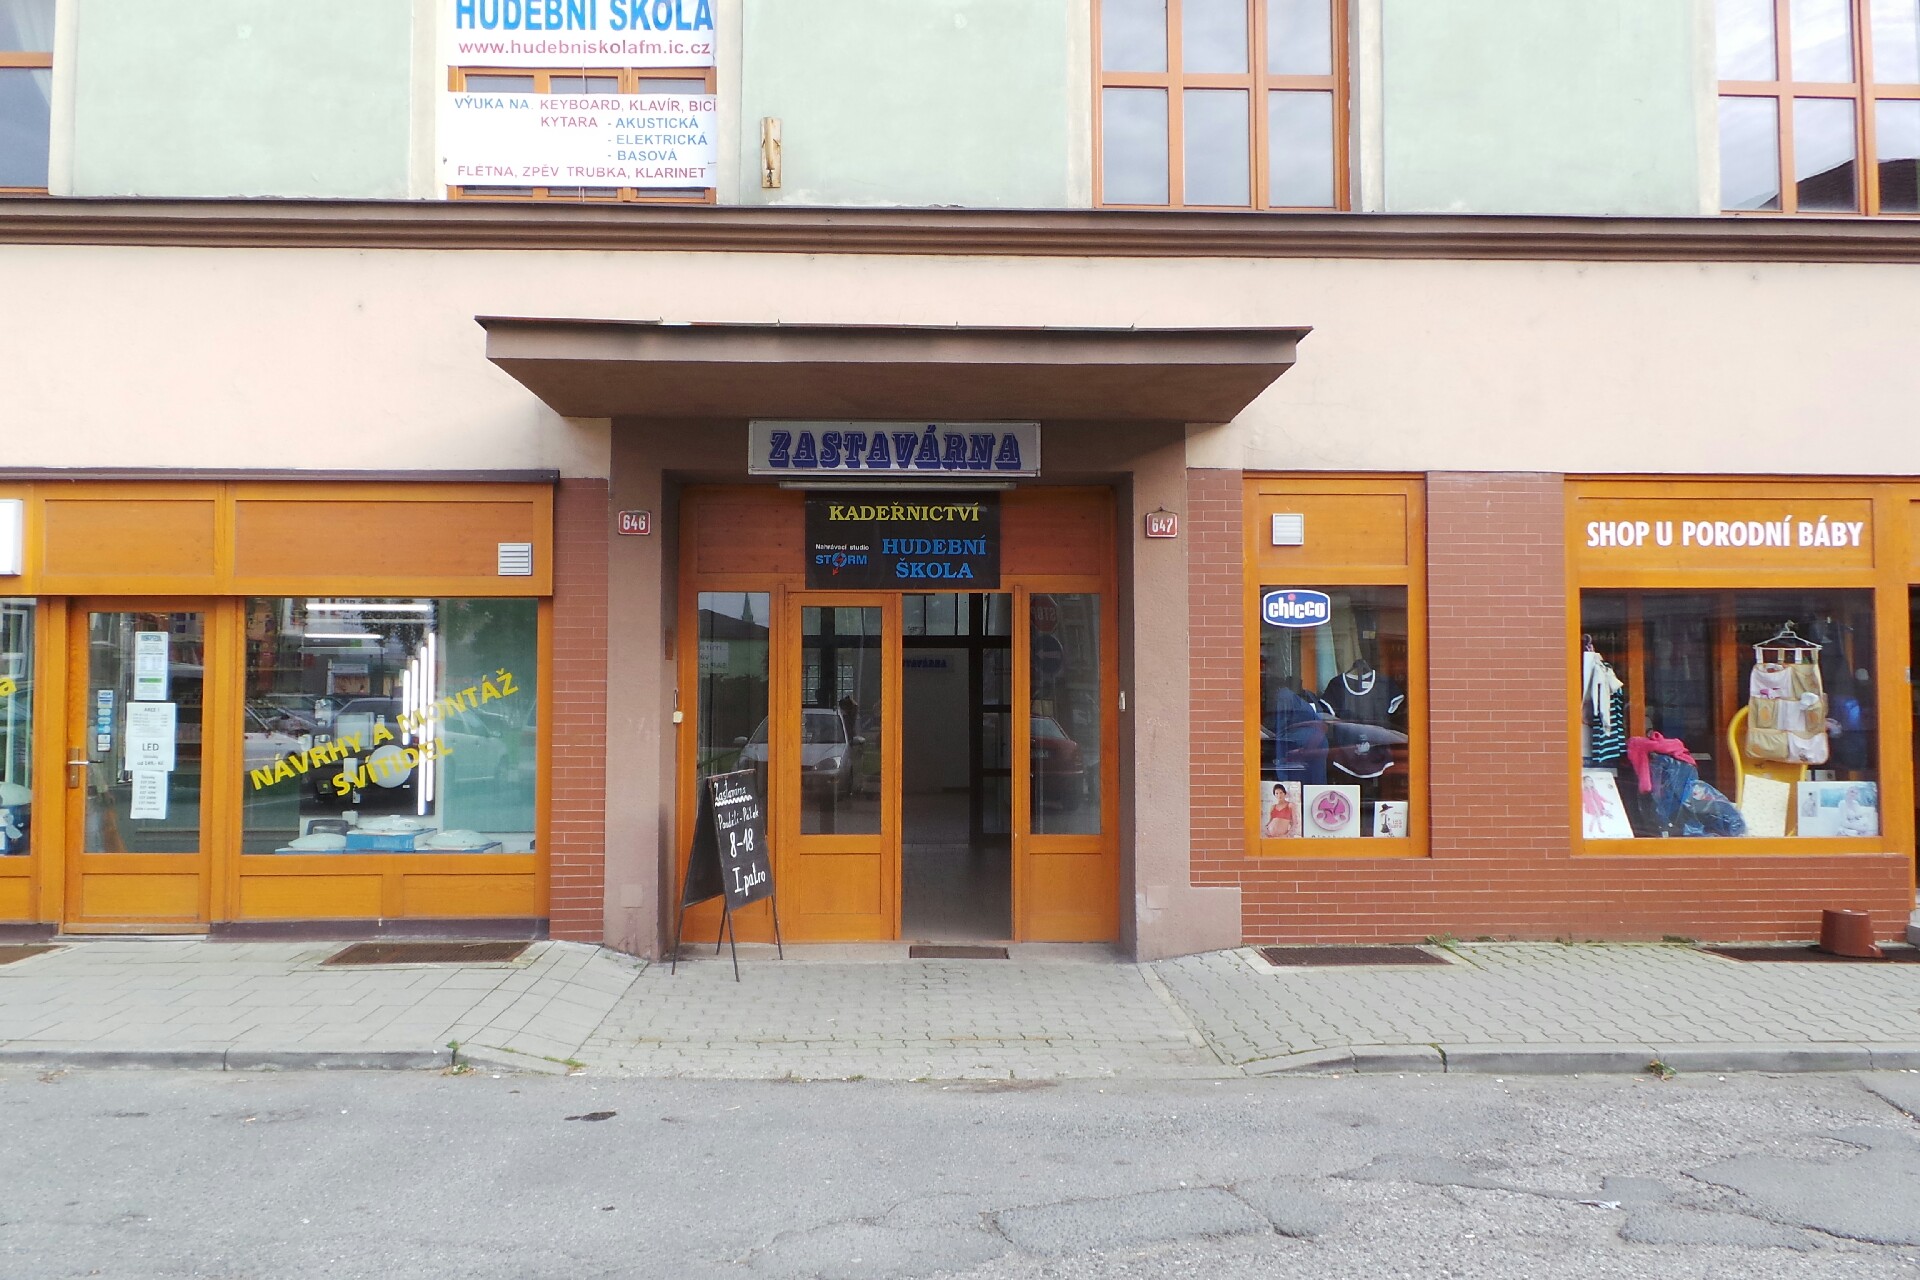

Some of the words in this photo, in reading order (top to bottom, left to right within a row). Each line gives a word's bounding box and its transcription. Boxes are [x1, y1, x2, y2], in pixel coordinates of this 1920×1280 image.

[458, 40, 711, 56] www.hudebniskolafm.ic.cz
[454, 95, 505, 109] VÝUKA
[540, 99, 624, 112] KEYBOARD,
[629, 98, 684, 114] KLAVÍR,
[540, 116, 598, 128] KYTARA
[616, 115, 699, 129] AKUSTICKÁ
[616, 132, 708, 145] ELEKTRICKÁ
[617, 148, 678, 161] BASOVÁ
[522, 164, 560, 177] ZPĚV
[567, 166, 631, 179] TRUBKA,
[635, 167, 707, 178] KLARINET
[768, 425, 1022, 470] ZASTAVÁRNA
[829, 501, 980, 522] KADEŘNICTVÍ
[623, 514, 646, 531] 646
[1151, 517, 1174, 533] 647
[1586, 520, 1651, 547] SHOP
[1655, 521, 1673, 547] U
[1682, 514, 1792, 547] PORODNÍ
[1798, 514, 1864, 547] BÁBY
[882, 534, 987, 555] HUDEBNÍ
[815, 552, 868, 568] STORM
[895, 557, 975, 579] ŠKOLA
[1268, 593, 1326, 619] chicco
[250, 731, 363, 791] NÁVRHY
[373, 723, 395, 746] A
[395, 667, 520, 734] MONTÁŽ
[142, 743, 160, 751] LED
[332, 737, 454, 796] SVÍTIDEL
